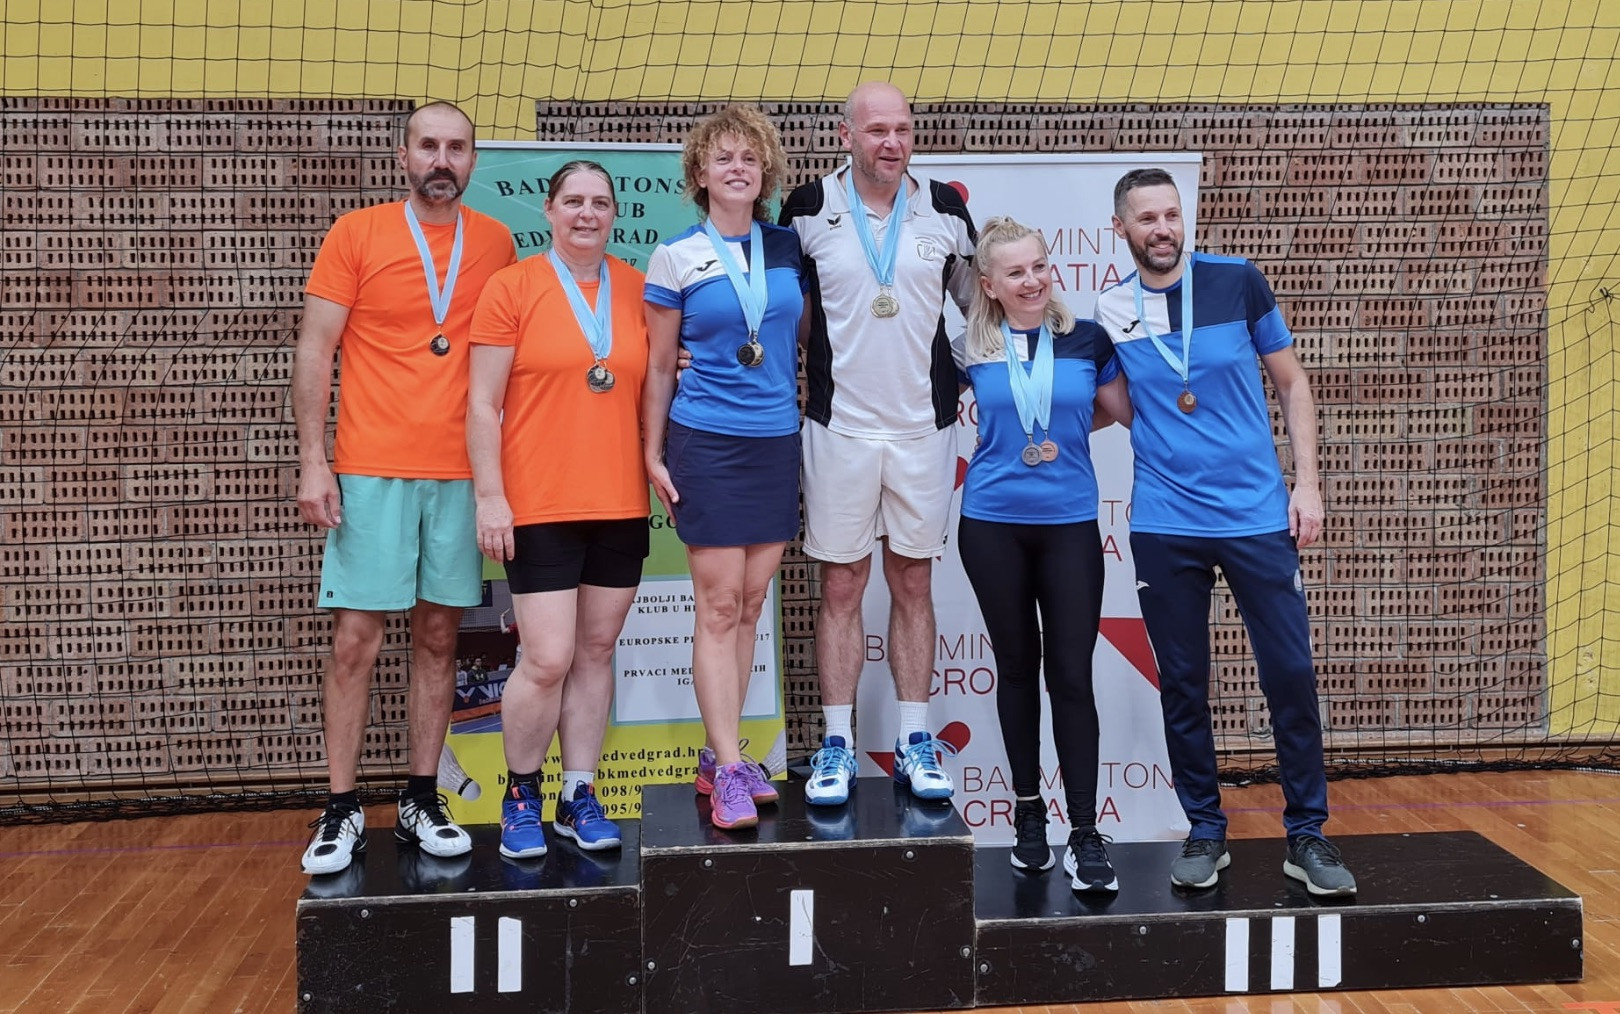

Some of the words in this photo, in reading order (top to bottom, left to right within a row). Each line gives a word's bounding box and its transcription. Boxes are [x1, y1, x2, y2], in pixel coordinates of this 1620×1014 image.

[1050, 263, 1121, 291] ATIA
[638, 606, 668, 614] KLUB
[673, 605, 680, 613] U
[619, 636, 680, 646] EUROPSKE
[624, 668, 667, 678] PRVACI
